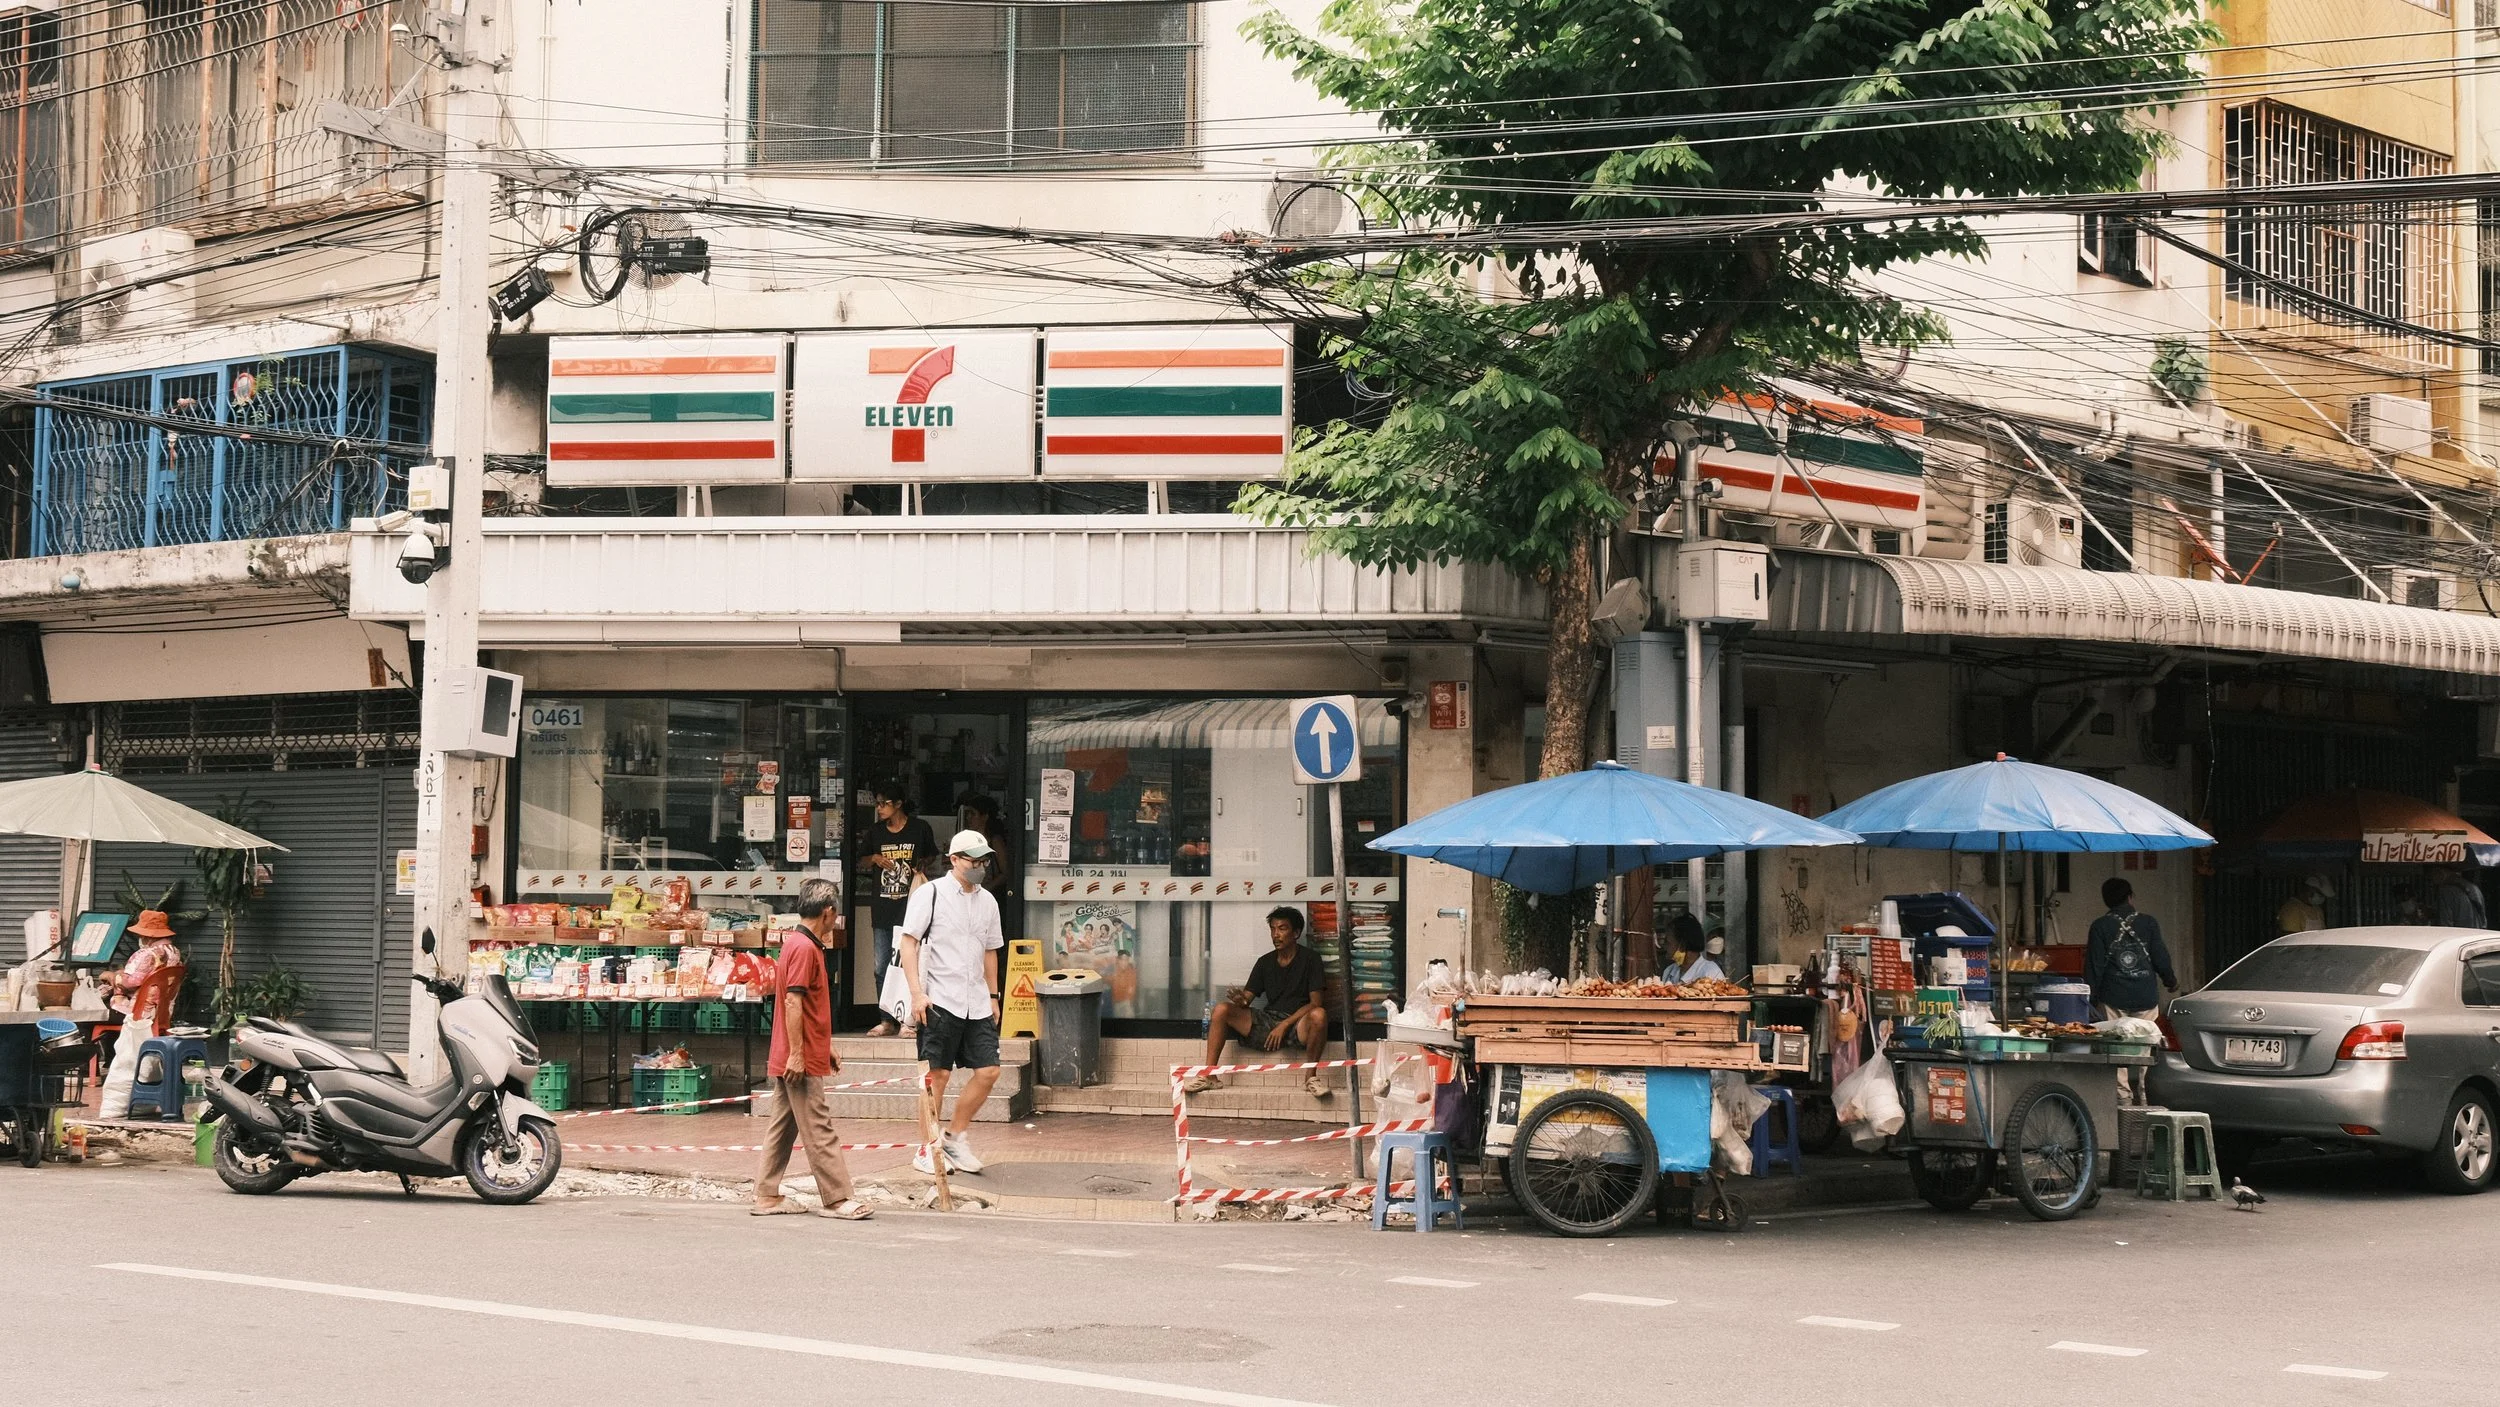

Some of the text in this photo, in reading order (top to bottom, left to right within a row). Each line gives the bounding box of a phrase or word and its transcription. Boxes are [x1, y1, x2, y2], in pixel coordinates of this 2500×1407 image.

[532, 708, 582, 726] 0461
[882, 850, 913, 860] FRENCH
[1090, 869, 1104, 878] 24
[1075, 904, 1103, 915] Good
